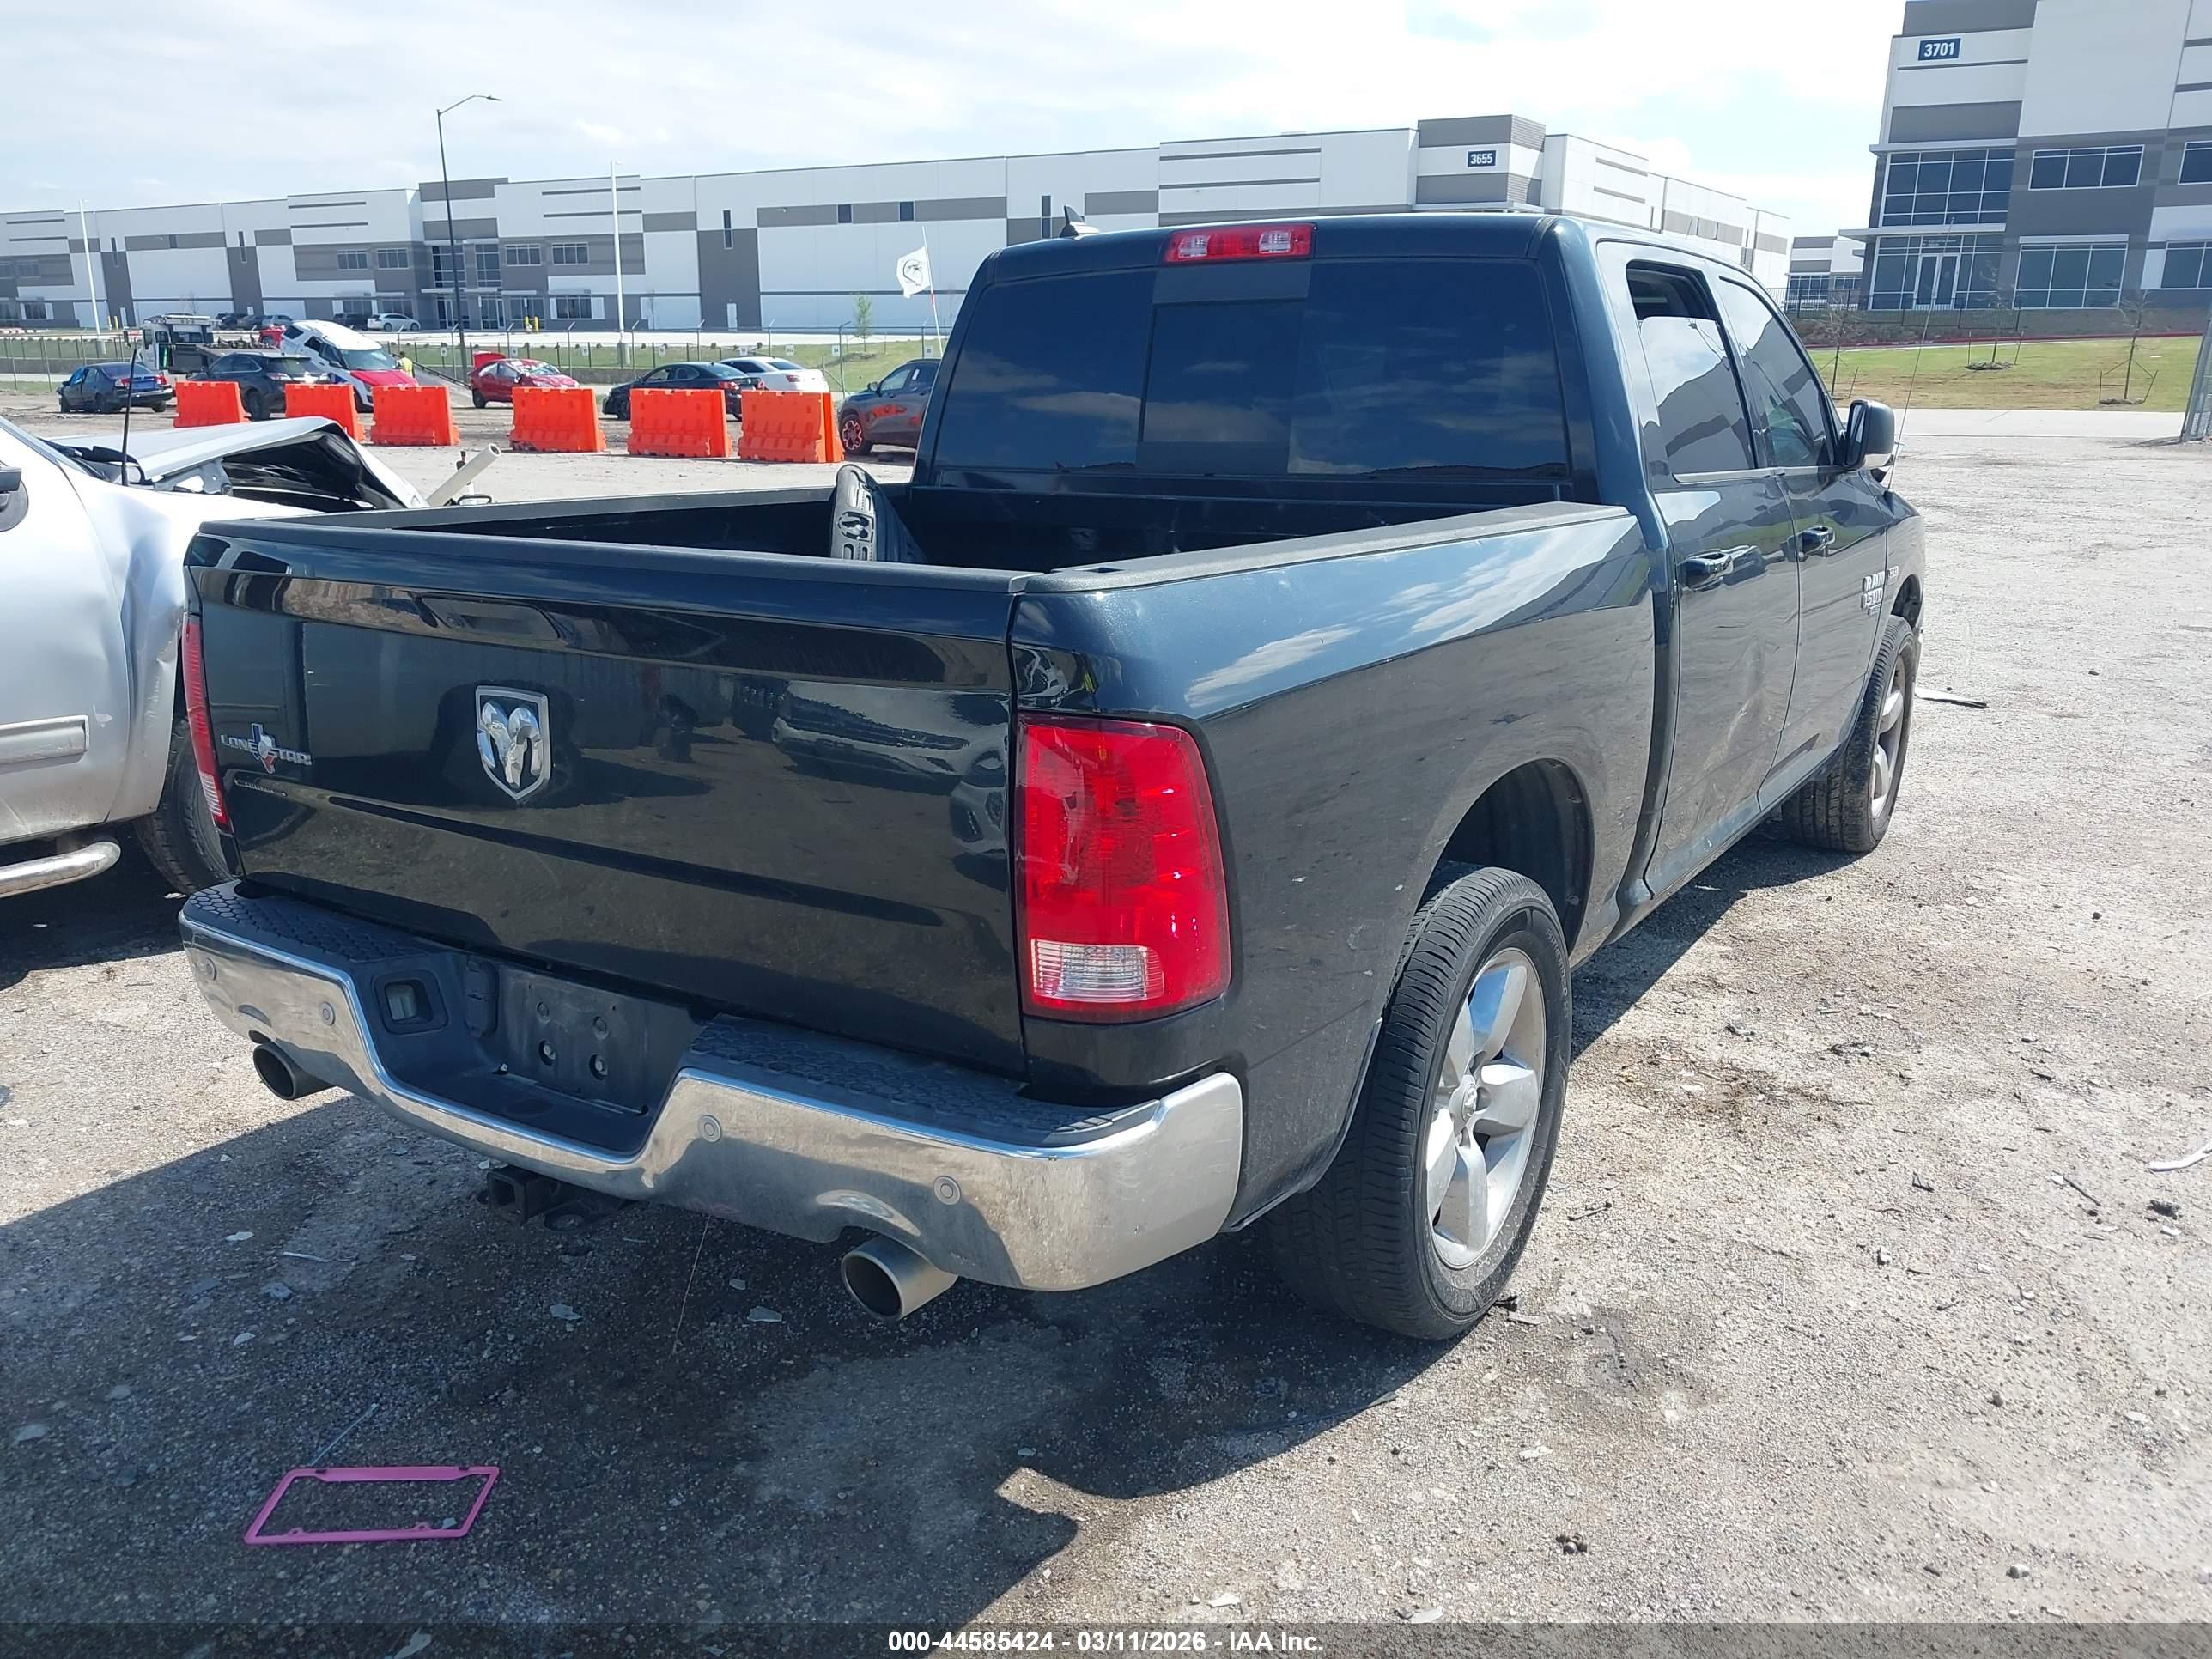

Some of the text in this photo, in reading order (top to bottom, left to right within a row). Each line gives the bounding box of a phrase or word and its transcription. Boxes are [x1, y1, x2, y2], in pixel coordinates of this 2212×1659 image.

[1923, 41, 1955, 58] 3701
[1470, 153, 1493, 165] 3655
[1863, 570, 1886, 592] RAM
[220, 734, 258, 754] LONE
[267, 747, 313, 766] STAR
